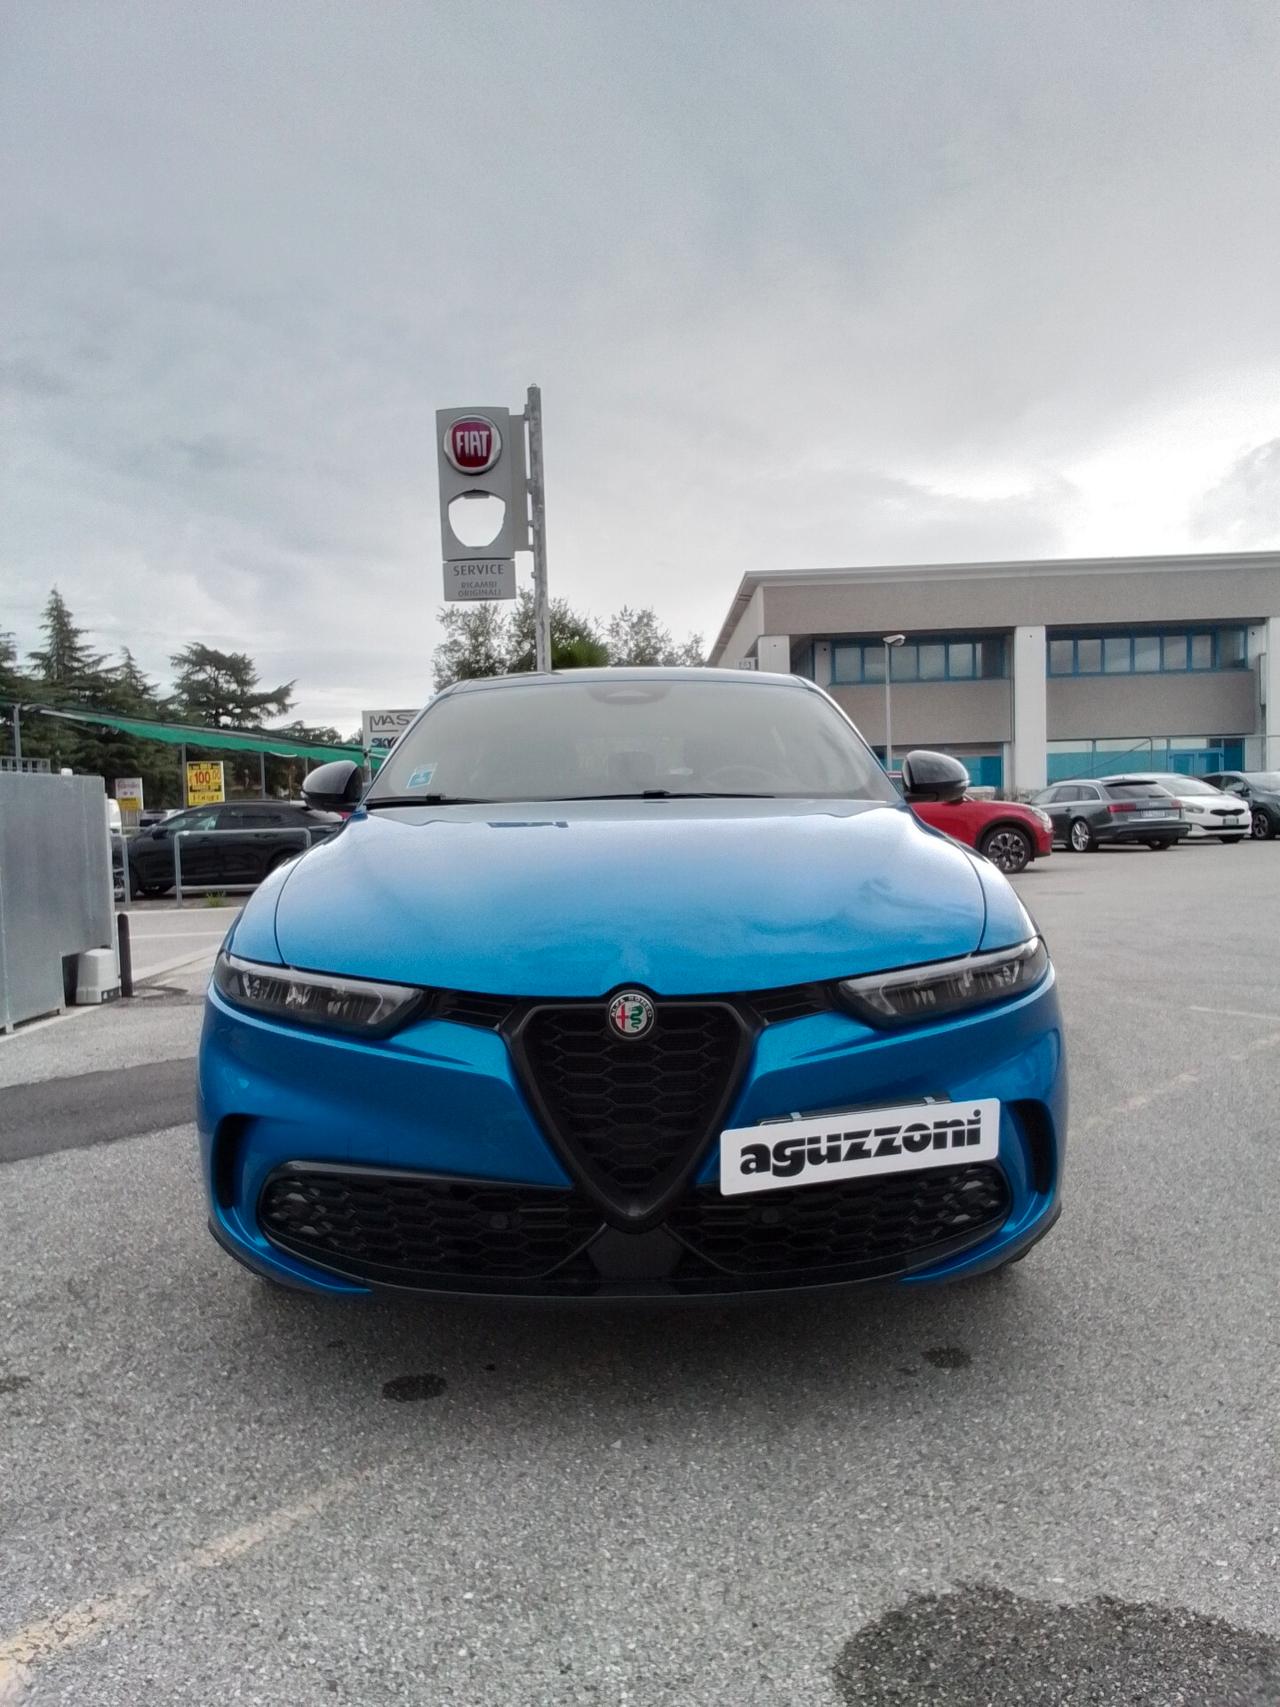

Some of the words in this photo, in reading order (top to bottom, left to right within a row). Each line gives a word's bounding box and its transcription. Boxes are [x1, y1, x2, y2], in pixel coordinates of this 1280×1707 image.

[455, 431, 490, 457] FIAT
[453, 564, 504, 577] SERVICE
[457, 589, 502, 598] ORIGINALI
[460, 581, 498, 590] RICAMBI
[610, 998, 626, 1018] ALFA
[628, 995, 653, 1018] ROMEO
[739, 1109, 982, 1178] aguzzoni
